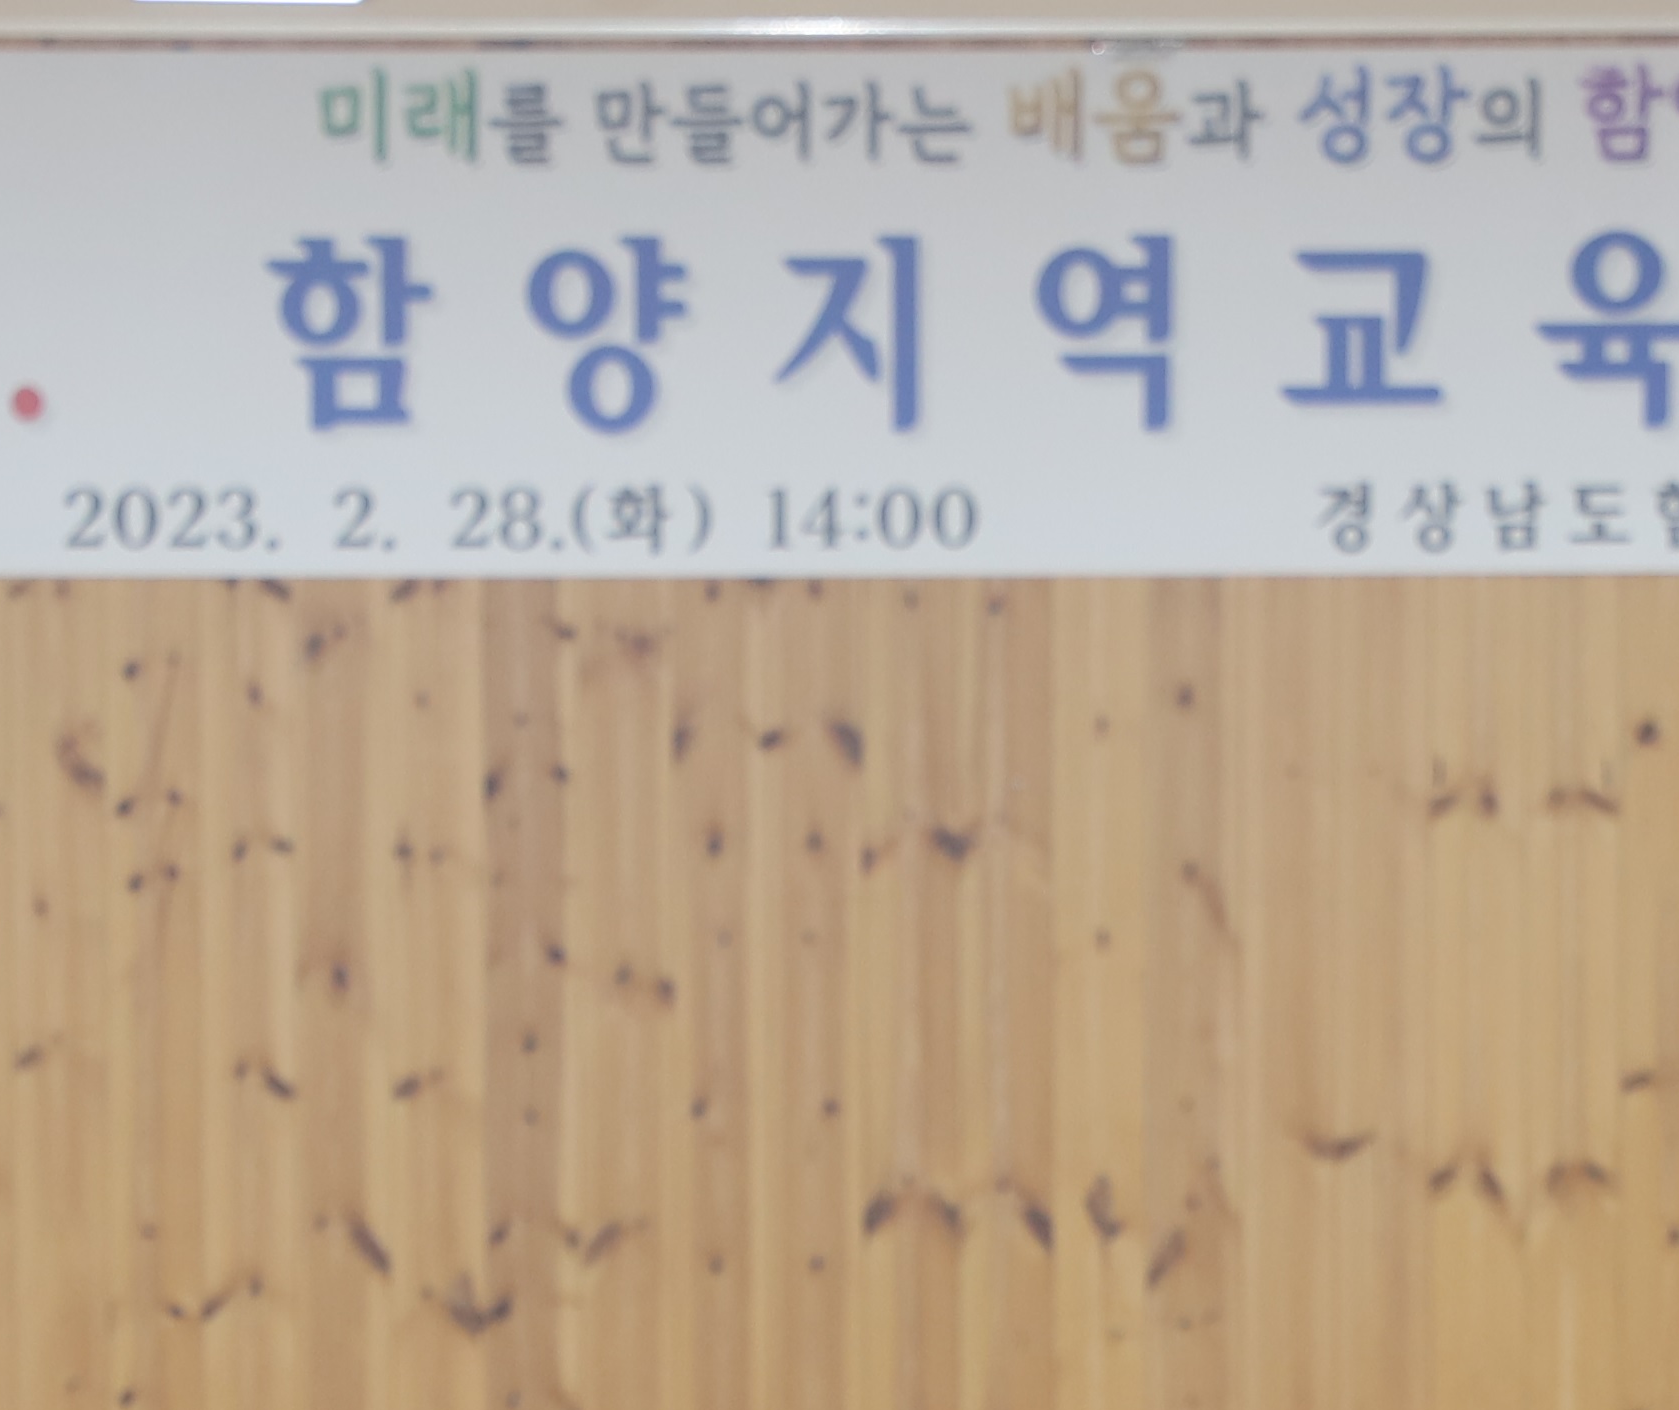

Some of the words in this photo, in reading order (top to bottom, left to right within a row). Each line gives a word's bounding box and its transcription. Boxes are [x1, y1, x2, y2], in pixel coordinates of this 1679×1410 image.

[319, 66, 563, 164] 미래를
[595, 79, 973, 164] 만들어가는
[1006, 66, 1264, 164] 배움과
[1299, 64, 1541, 164] 성장의
[63, 486, 281, 551] 2023.
[333, 486, 396, 551] 2.
[765, 487, 981, 549] 14:00
